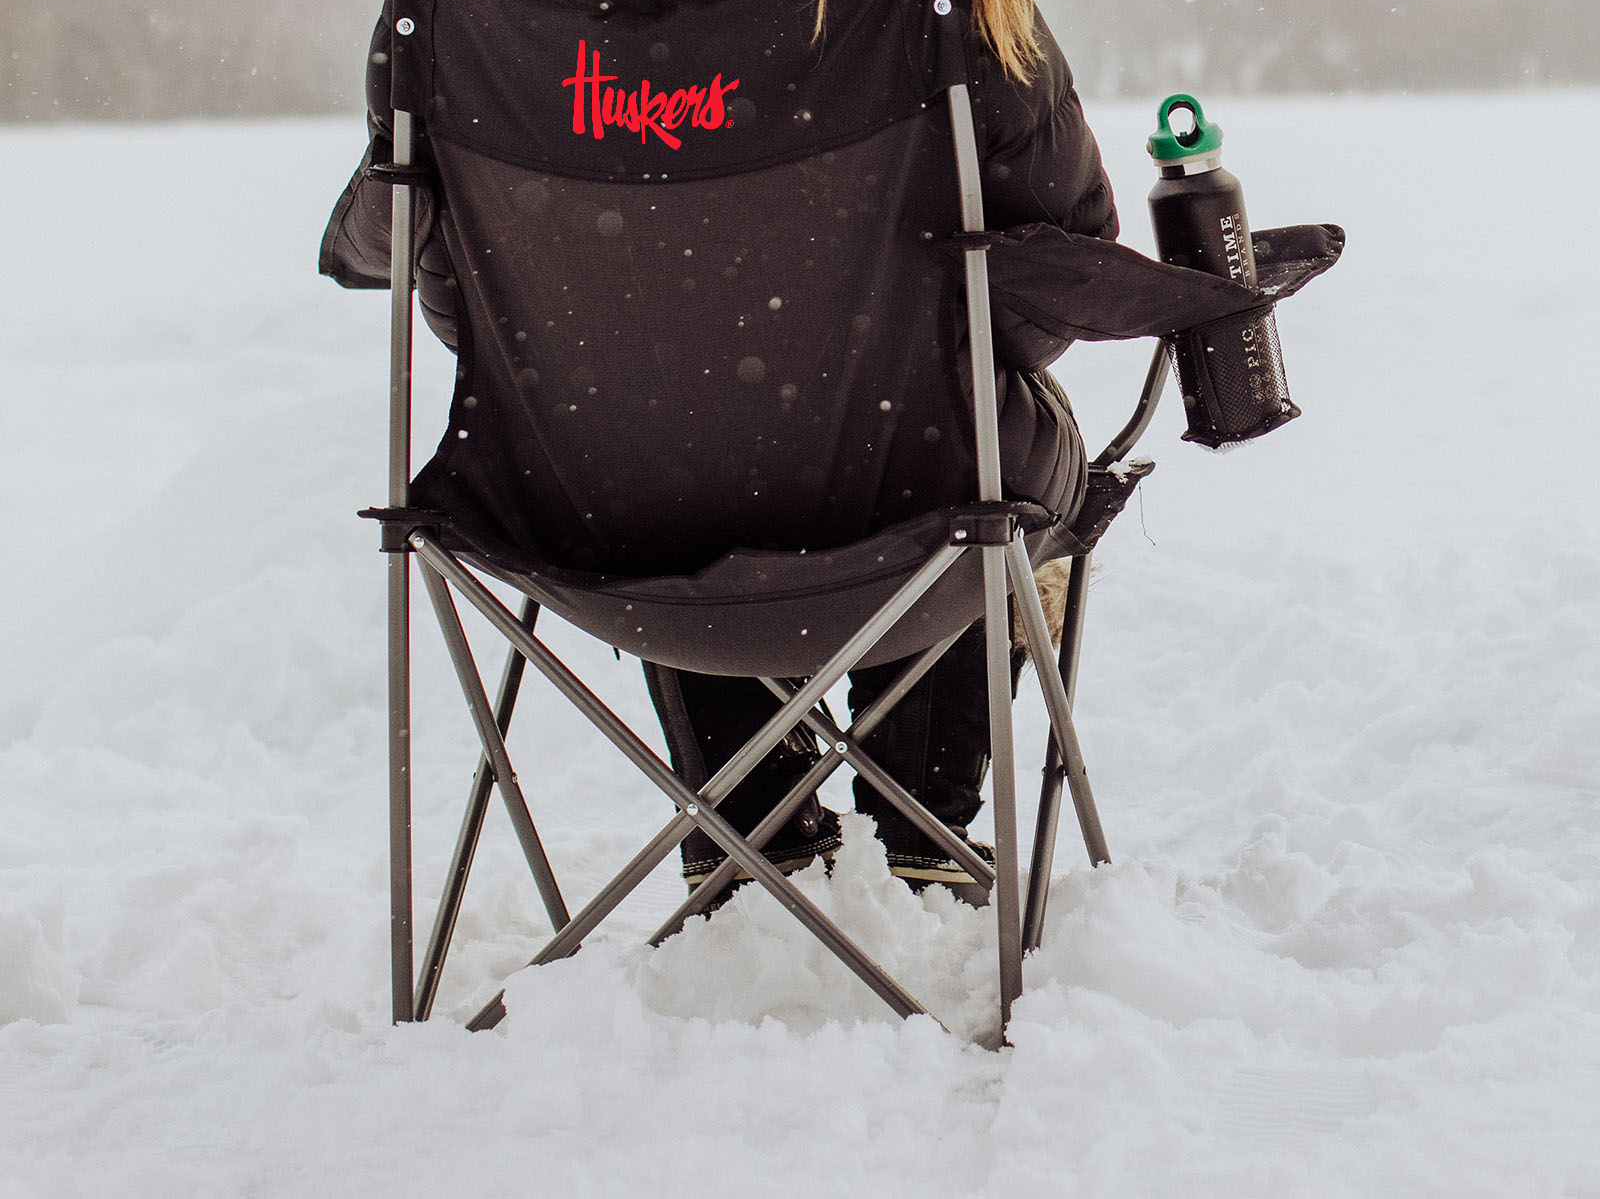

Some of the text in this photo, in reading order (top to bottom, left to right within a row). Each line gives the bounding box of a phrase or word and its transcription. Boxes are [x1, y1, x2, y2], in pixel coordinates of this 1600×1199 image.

[562, 39, 740, 151] Huskers
[1220, 215, 1260, 369] PIC TIME
